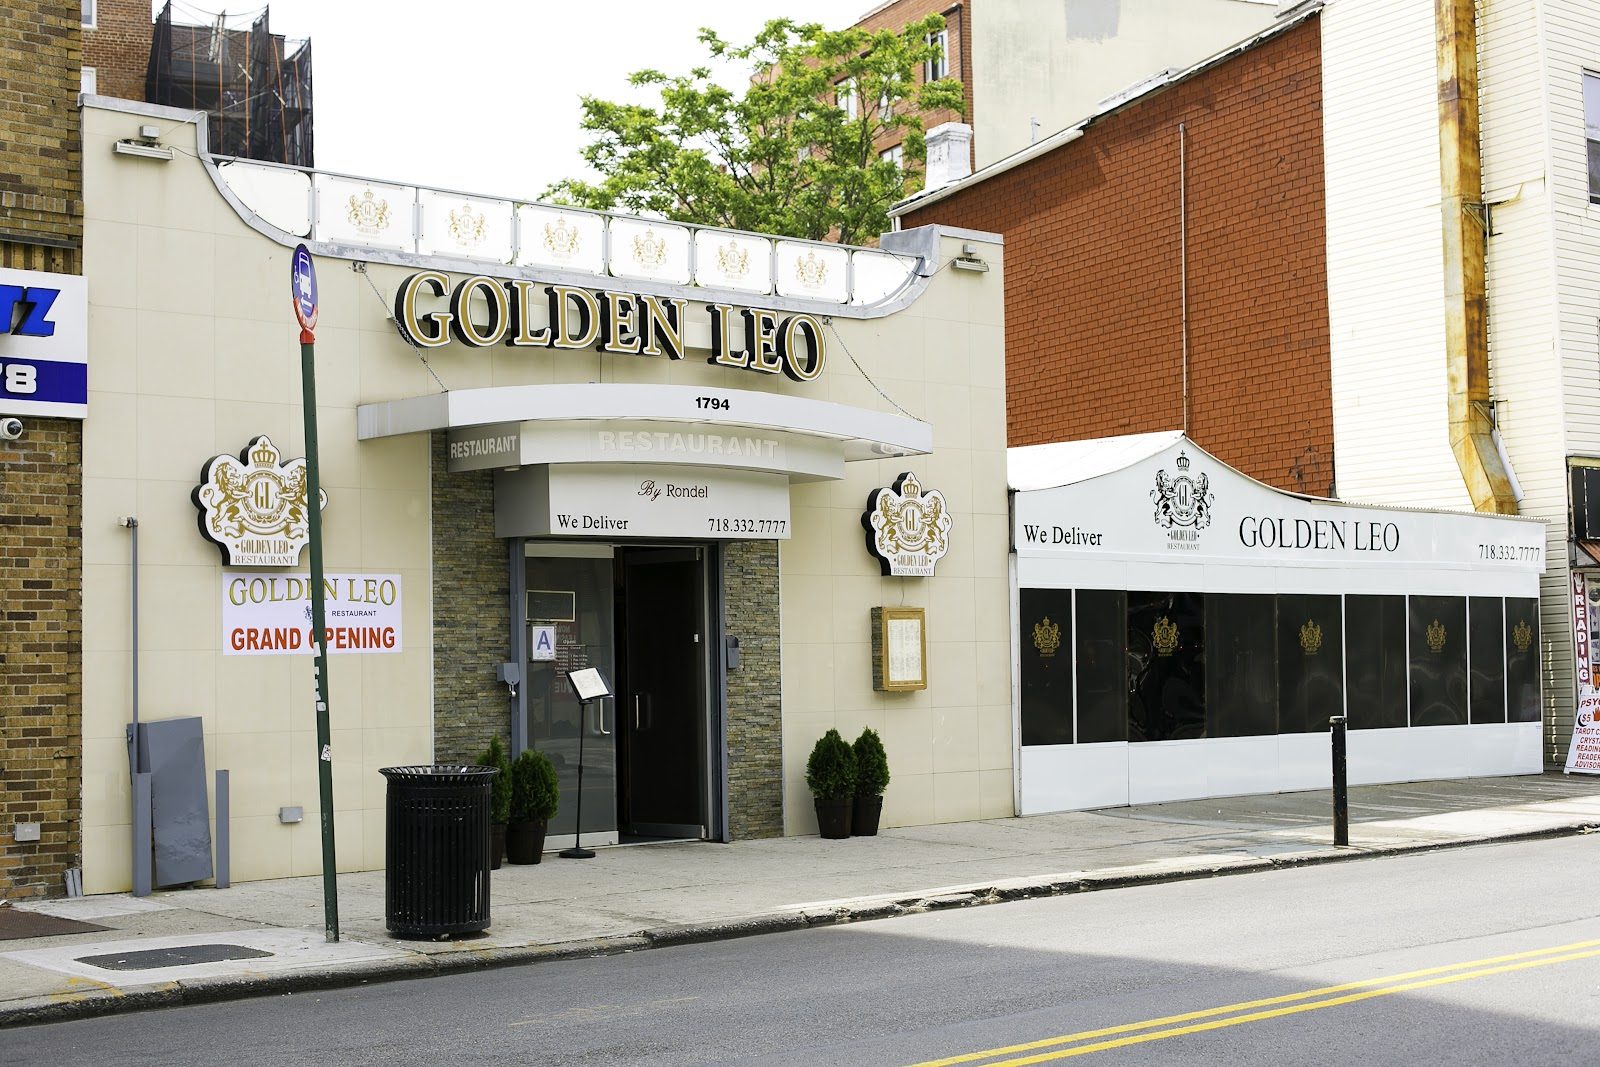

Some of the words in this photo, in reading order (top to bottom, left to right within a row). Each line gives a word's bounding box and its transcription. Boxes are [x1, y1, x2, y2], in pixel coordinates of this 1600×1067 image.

[395, 270, 689, 361] GOLDEN
[707, 303, 827, 382] LEO
[0, 363, 37, 394] 8
[695, 396, 730, 411] 1794
[450, 435, 517, 459] RESTAURANT
[598, 431, 779, 460] RESTAURANT
[254, 481, 274, 509] GL
[638, 479, 662, 501] By
[666, 484, 709, 499] Rondel
[557, 514, 578, 530] We
[582, 515, 629, 531] Deliver
[708, 518, 787, 534] 718.332.7777
[905, 508, 918, 531] GL
[1023, 524, 1048, 543] We
[1053, 526, 1103, 547] Deliver
[1239, 516, 1346, 550] GOLDEN
[1353, 521, 1400, 552] LEO
[240, 539, 272, 554] GOLDEN
[273, 540, 289, 554] LEO
[1478, 544, 1541, 562] 718.332.7777
[235, 555, 295, 565] RESTAURANT
[893, 567, 932, 575] RESTAURANT
[348, 578, 397, 606] LEO
[231, 627, 301, 651] GRAND
[536, 630, 551, 651] A
[1574, 594, 1590, 681] READING
[1576, 744, 1600, 752] READIN
[1580, 736, 1600, 745] CRYST
